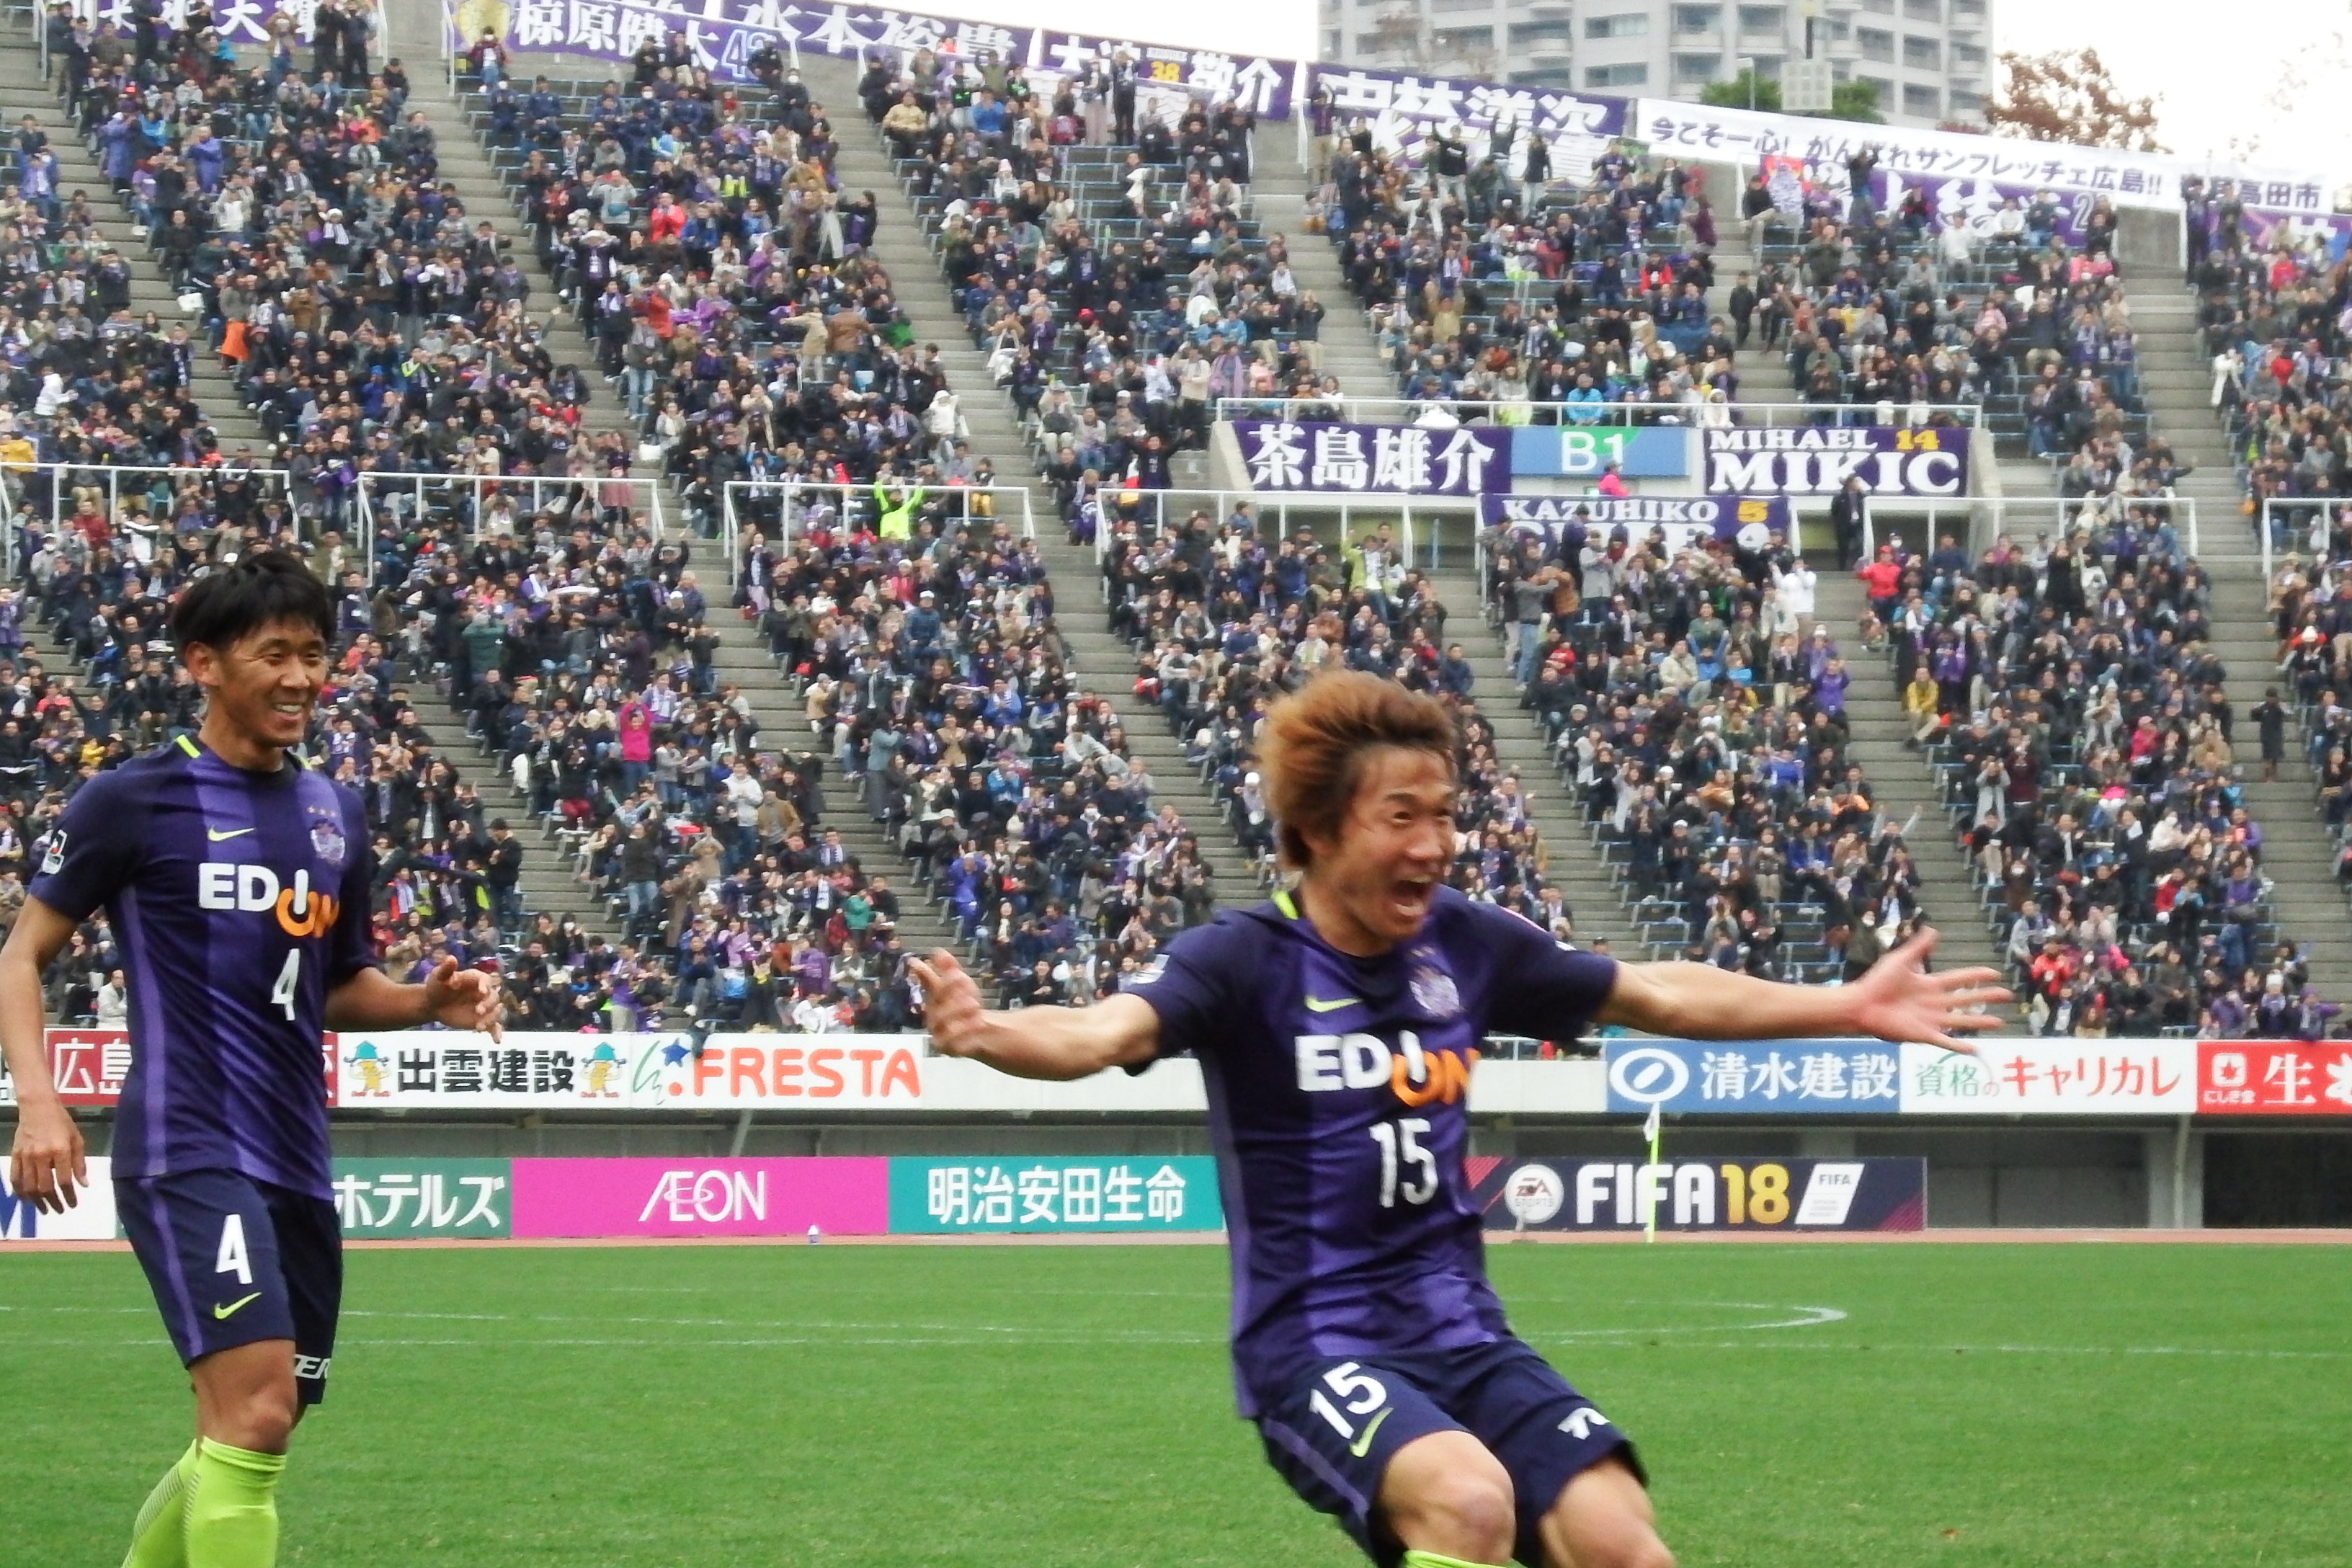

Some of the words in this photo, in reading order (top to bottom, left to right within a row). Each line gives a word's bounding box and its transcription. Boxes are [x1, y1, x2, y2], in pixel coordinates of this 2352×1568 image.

[1247, 423, 1496, 491] 茶島雄介
[1561, 431, 1624, 473] B1
[1709, 429, 1879, 450] MIHAEL
[1895, 429, 1940, 451] 14
[1709, 452, 1960, 494] MIKIC
[1502, 499, 1720, 522] KAZUHIKO
[1737, 499, 1769, 523] 5
[198, 862, 339, 938] EDION
[271, 948, 300, 1021] 4
[397, 1048, 575, 1094] 出雲建設
[1295, 1029, 1482, 1108] EDION
[1701, 1051, 1899, 1100] 清水建設
[1369, 1117, 1440, 1208] 15
[1818, 1173, 1852, 1185] FIFA
[926, 1164, 1187, 1226] 明治安田生命
[1576, 1163, 1716, 1224] FIFA
[1720, 1163, 1791, 1224] 18
[215, 1213, 253, 1285] 4
[1309, 1360, 1388, 1440] 15
